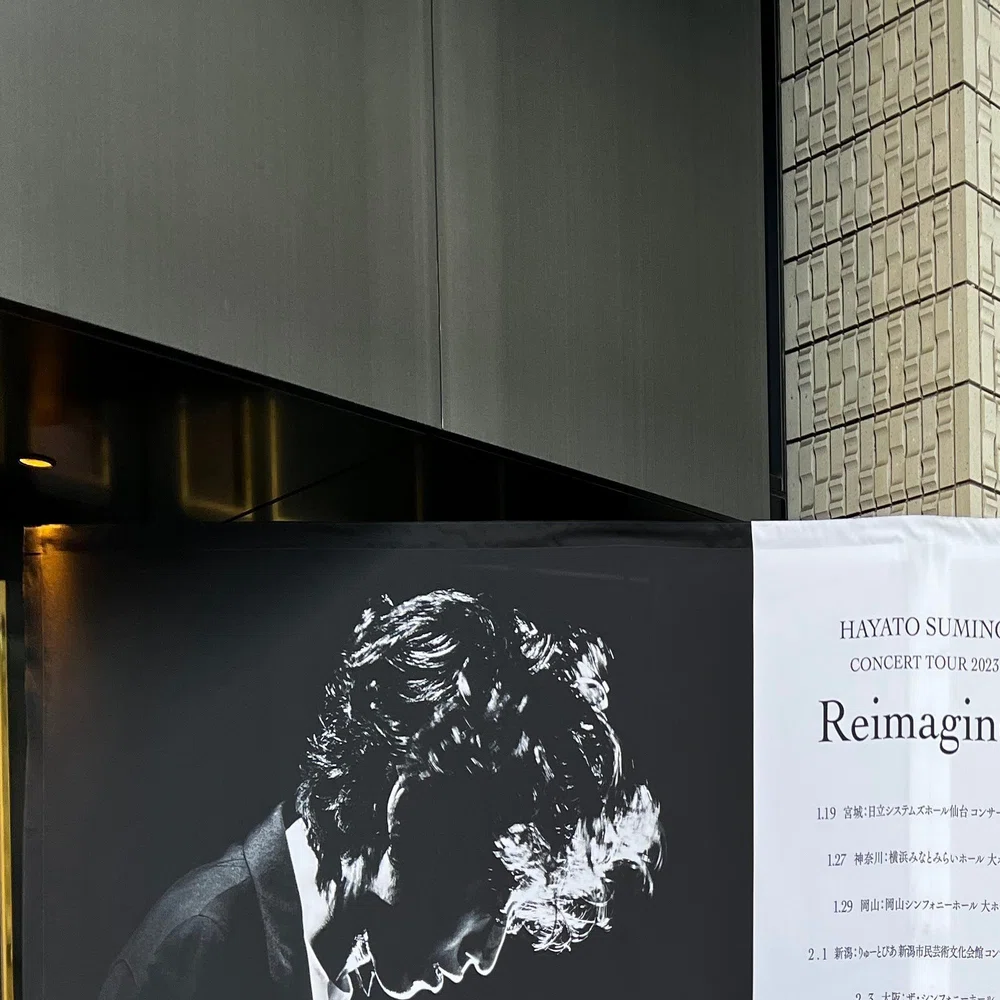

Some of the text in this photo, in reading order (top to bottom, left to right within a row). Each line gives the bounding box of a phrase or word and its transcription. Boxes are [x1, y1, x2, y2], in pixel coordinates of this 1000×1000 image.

[840, 617, 920, 639] HAYATO
[850, 655, 999, 673] CONCERT TOUR 2023
[818, 806, 836, 821] 1.19
[828, 853, 847, 867] 1.27
[834, 899, 853, 914] 1.29
